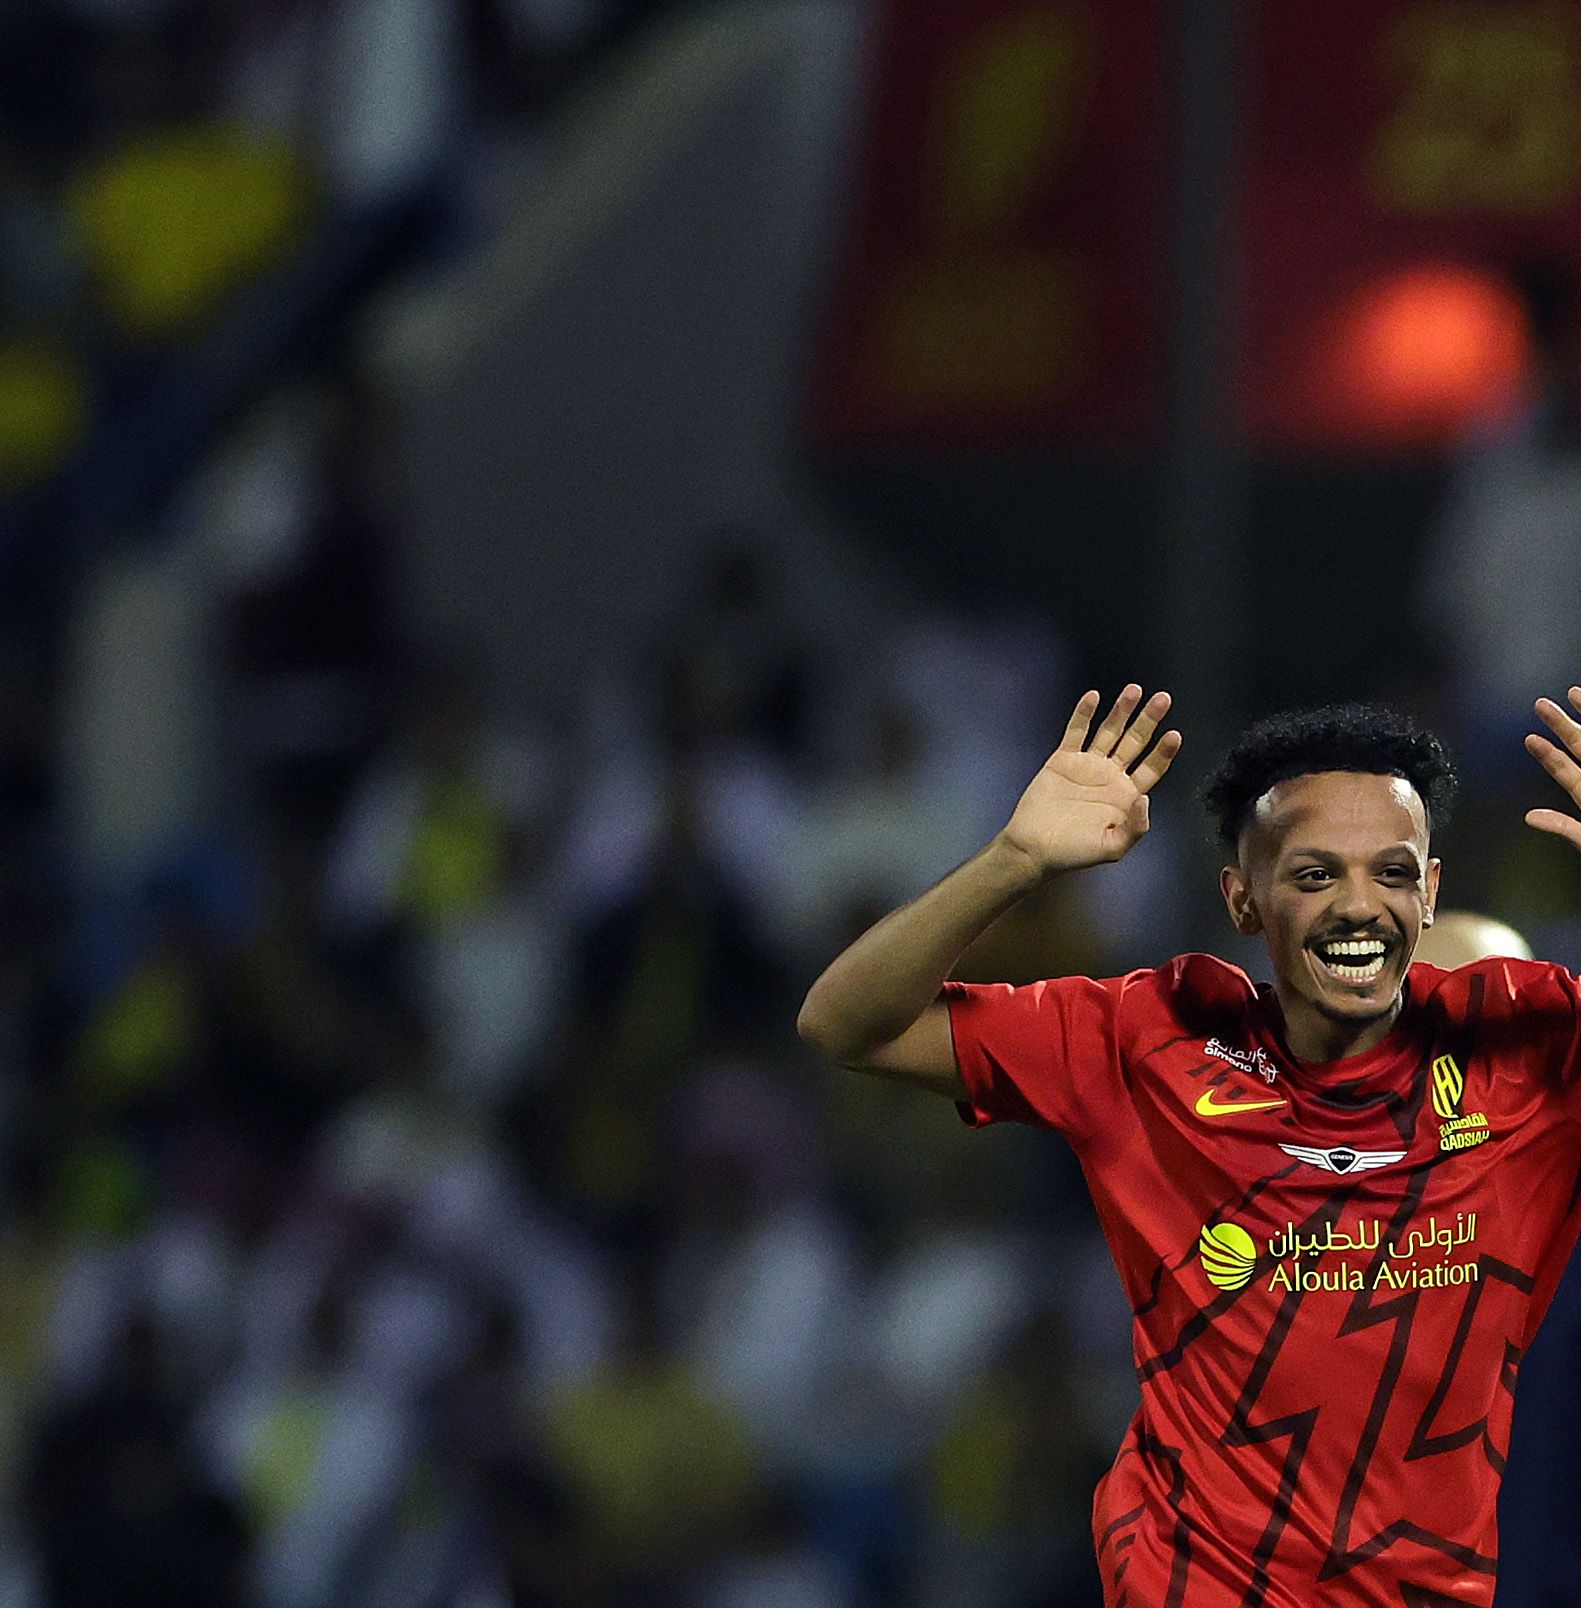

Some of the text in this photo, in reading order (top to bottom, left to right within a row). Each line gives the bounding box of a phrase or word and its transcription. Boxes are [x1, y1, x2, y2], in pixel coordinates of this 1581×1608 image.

[1268, 1213, 1476, 1260] الأولى للطيران
[1268, 1260, 1479, 1292] Aloula Aviation
